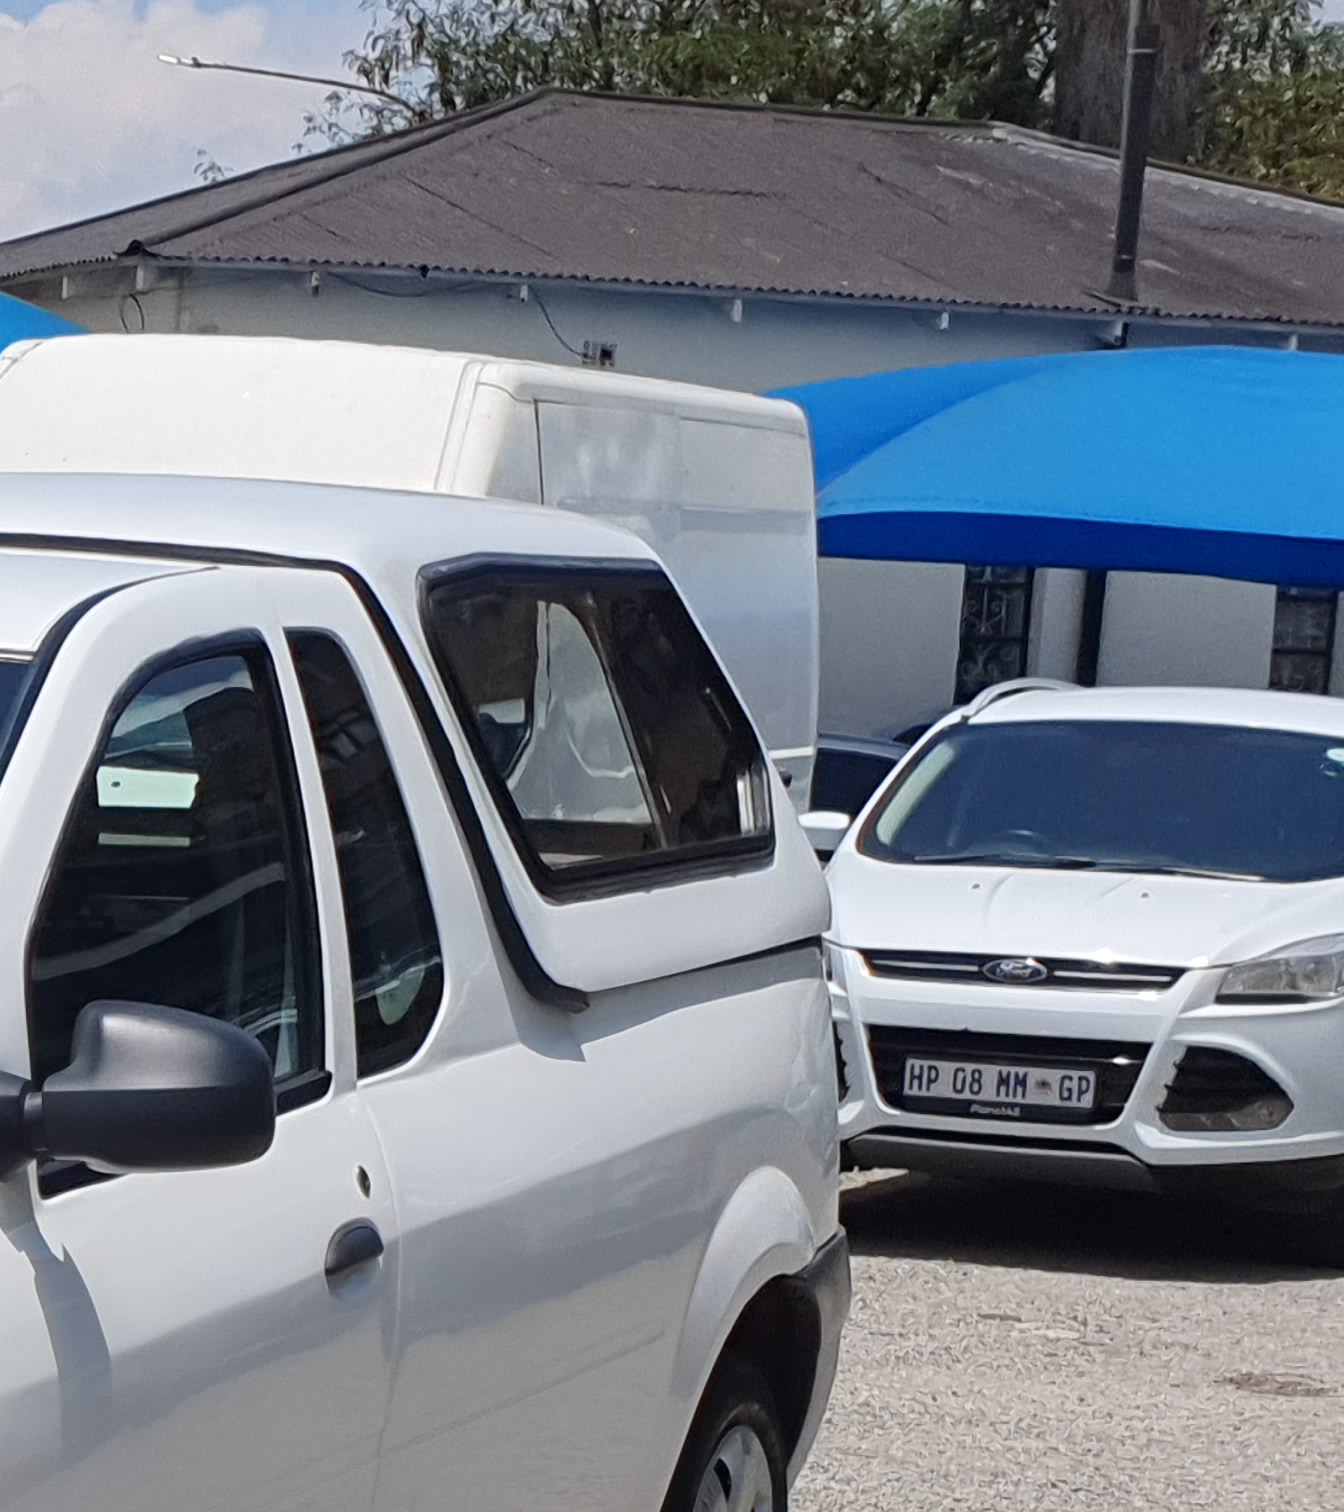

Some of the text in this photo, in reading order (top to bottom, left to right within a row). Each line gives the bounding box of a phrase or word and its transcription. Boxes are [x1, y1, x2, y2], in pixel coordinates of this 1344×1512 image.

[908, 1064, 939, 1092] HP
[952, 1067, 983, 1095] 08
[1059, 1074, 1091, 1102] GP
